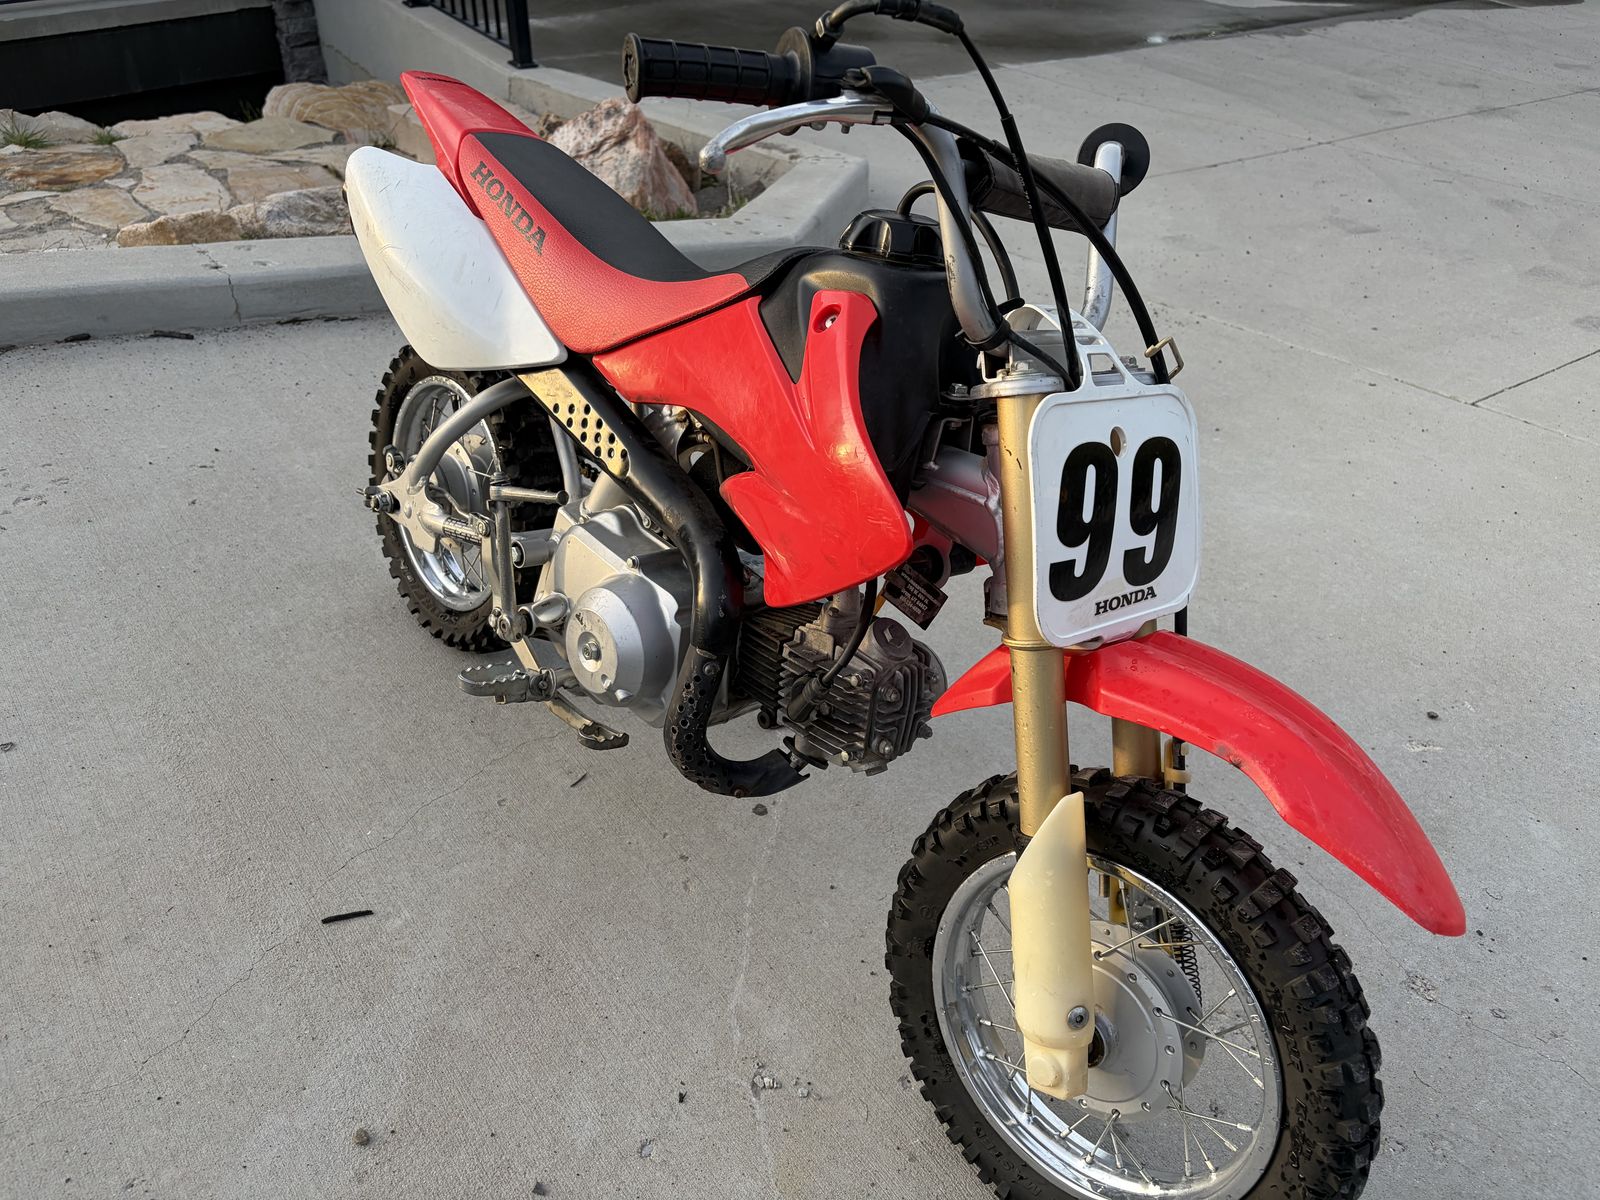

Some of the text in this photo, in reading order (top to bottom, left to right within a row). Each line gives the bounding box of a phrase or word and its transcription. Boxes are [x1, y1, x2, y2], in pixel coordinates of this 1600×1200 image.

[470, 160, 547, 256] HONDA
[1049, 436, 1181, 602] 99
[1094, 585, 1157, 616] HONDA
